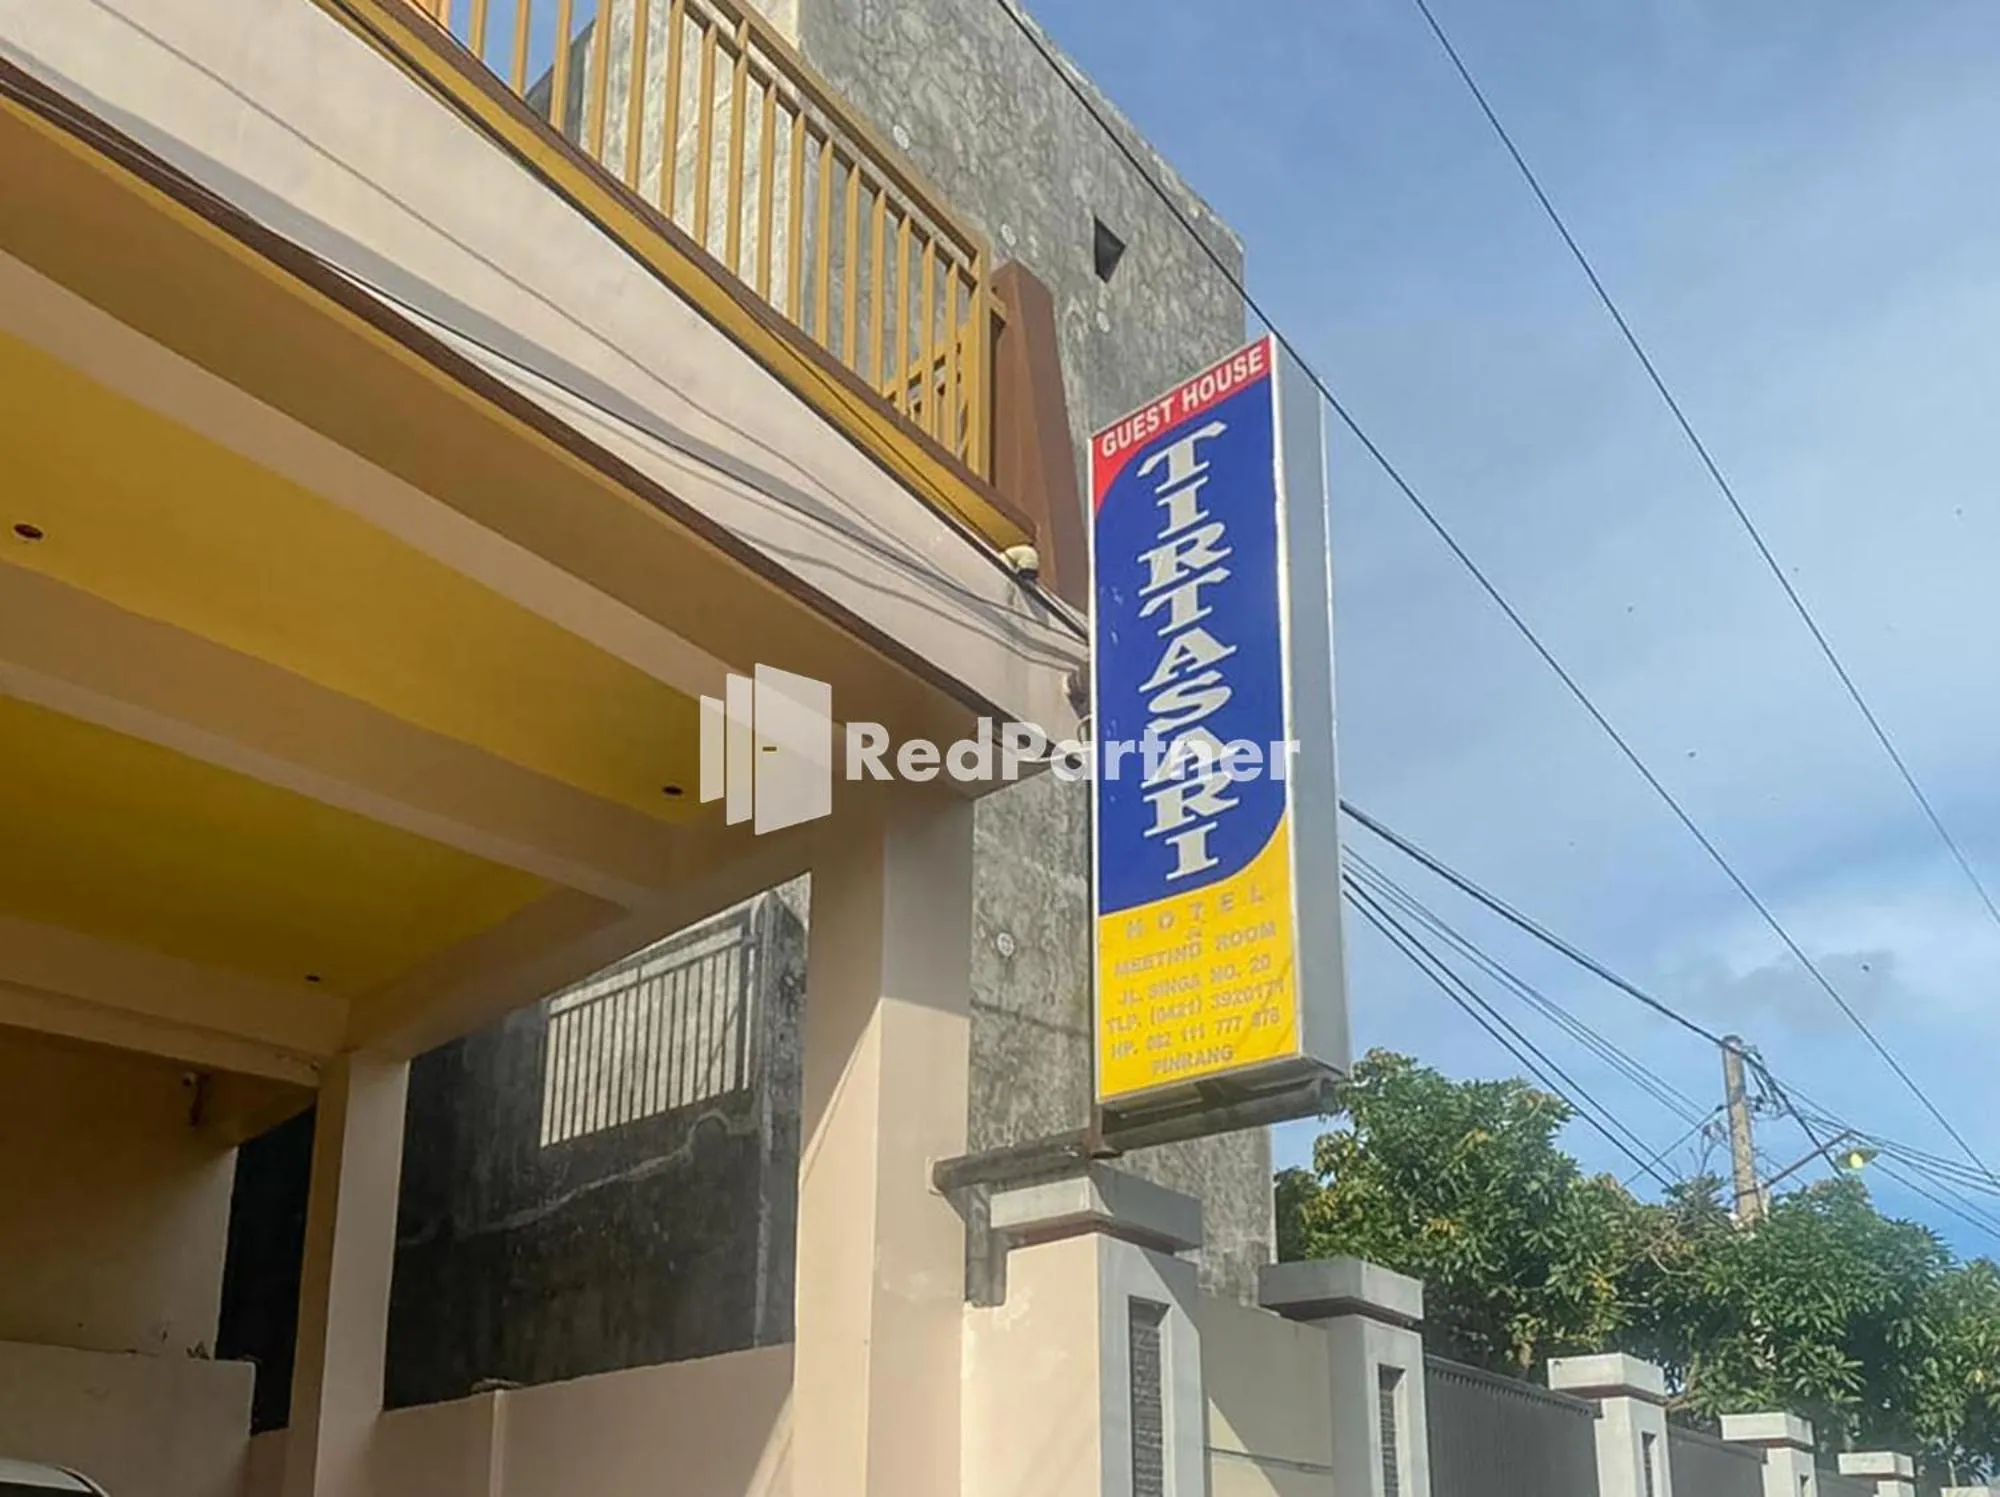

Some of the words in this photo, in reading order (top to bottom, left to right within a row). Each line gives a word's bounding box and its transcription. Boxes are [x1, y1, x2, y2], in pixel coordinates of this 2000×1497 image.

[1102, 397, 1175, 457] GUEST
[1181, 346, 1263, 411] HOUSE
[1136, 420, 1240, 881] TIRTASARI
[1114, 940, 1201, 976] MEETING
[1215, 921, 1277, 951] ROOM
[1152, 1043, 1234, 1076] PINRANG
